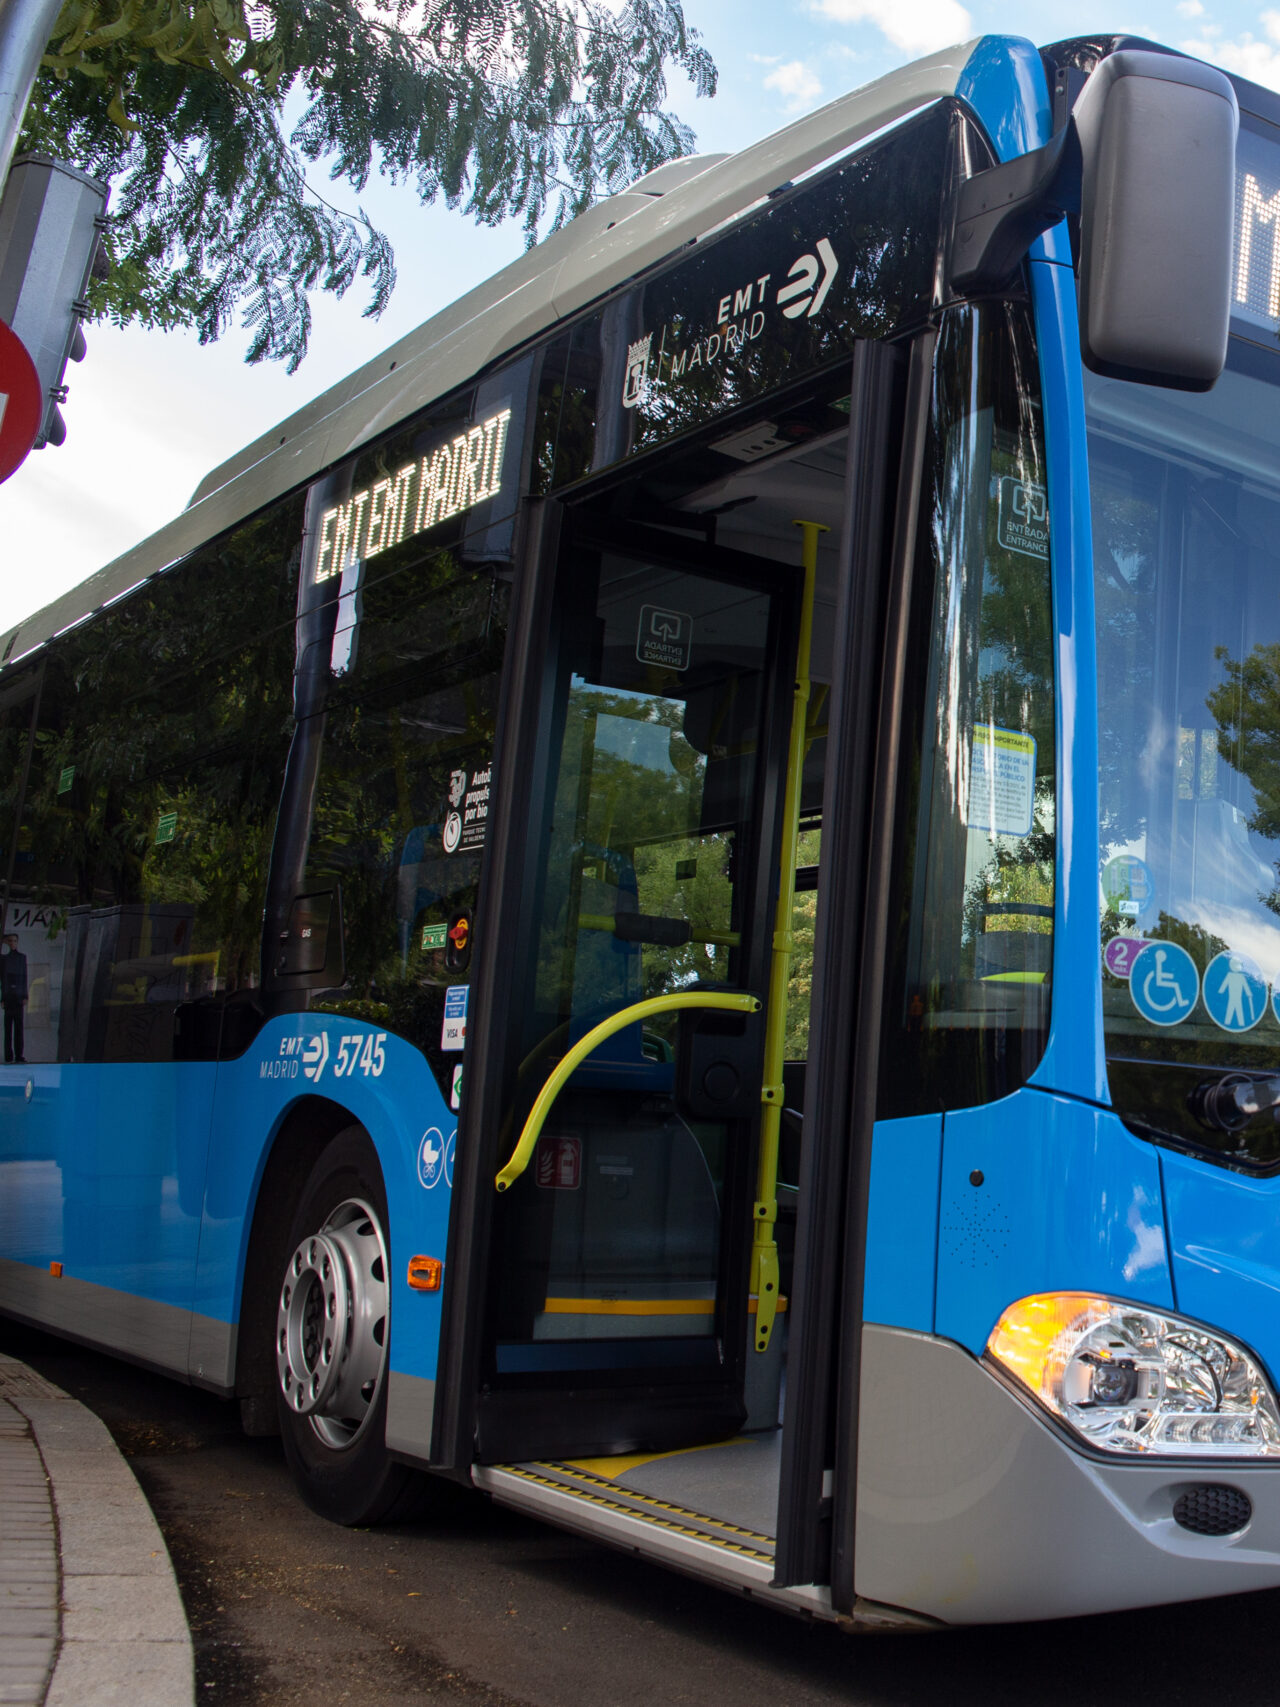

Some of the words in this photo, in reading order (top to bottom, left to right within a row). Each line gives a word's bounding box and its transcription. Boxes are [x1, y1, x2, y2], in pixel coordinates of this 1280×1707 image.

[717, 273, 771, 325] EMT
[670, 311, 765, 381] MADRID
[315, 490, 369, 584] EMT
[364, 462, 416, 559] EMT
[1006, 521, 1048, 541] ENTRADA
[1006, 534, 1048, 554] ENTRANCE
[464, 808, 477, 824] por
[1114, 942, 1128, 965] 2
[446, 1028, 458, 1039] VISA
[279, 1037, 304, 1056] EMT
[334, 1033, 387, 1078] 5745
[259, 1060, 299, 1079] MADRID
